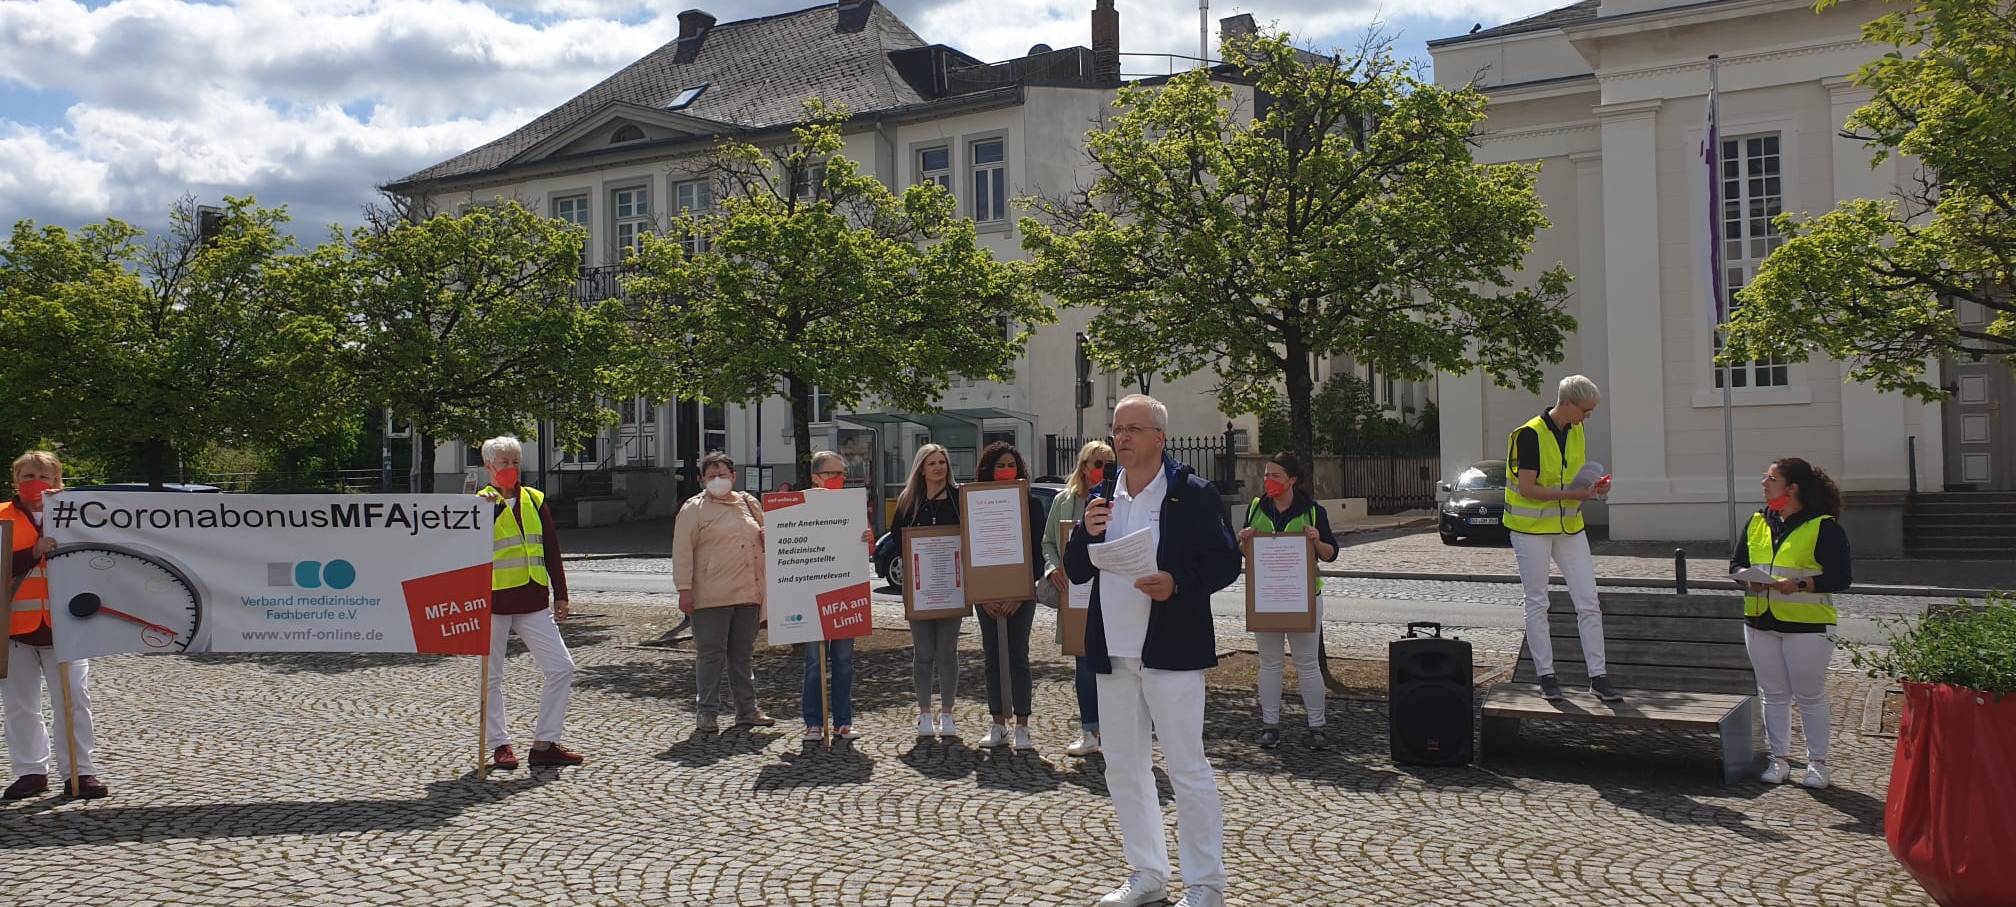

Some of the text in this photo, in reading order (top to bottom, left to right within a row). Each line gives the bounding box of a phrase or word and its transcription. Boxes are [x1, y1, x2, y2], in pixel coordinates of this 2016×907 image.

[51, 500, 482, 535] #CoronabonusMFAjetzt
[777, 518, 850, 529] mehr Anerkennung:
[778, 536, 808, 545] 400.000
[777, 546, 826, 555] Medizinische
[777, 555, 836, 566] Fachangestellte
[777, 571, 851, 584] sind systemrelevant
[241, 595, 381, 607] Verband medizinischer
[821, 596, 868, 617] MFA am
[266, 609, 358, 620] Fachberufe e.V.
[425, 597, 486, 620] MFA am
[440, 616, 481, 638] Limit
[833, 612, 864, 629] Limit
[241, 628, 384, 641] www.vmf-online.de
